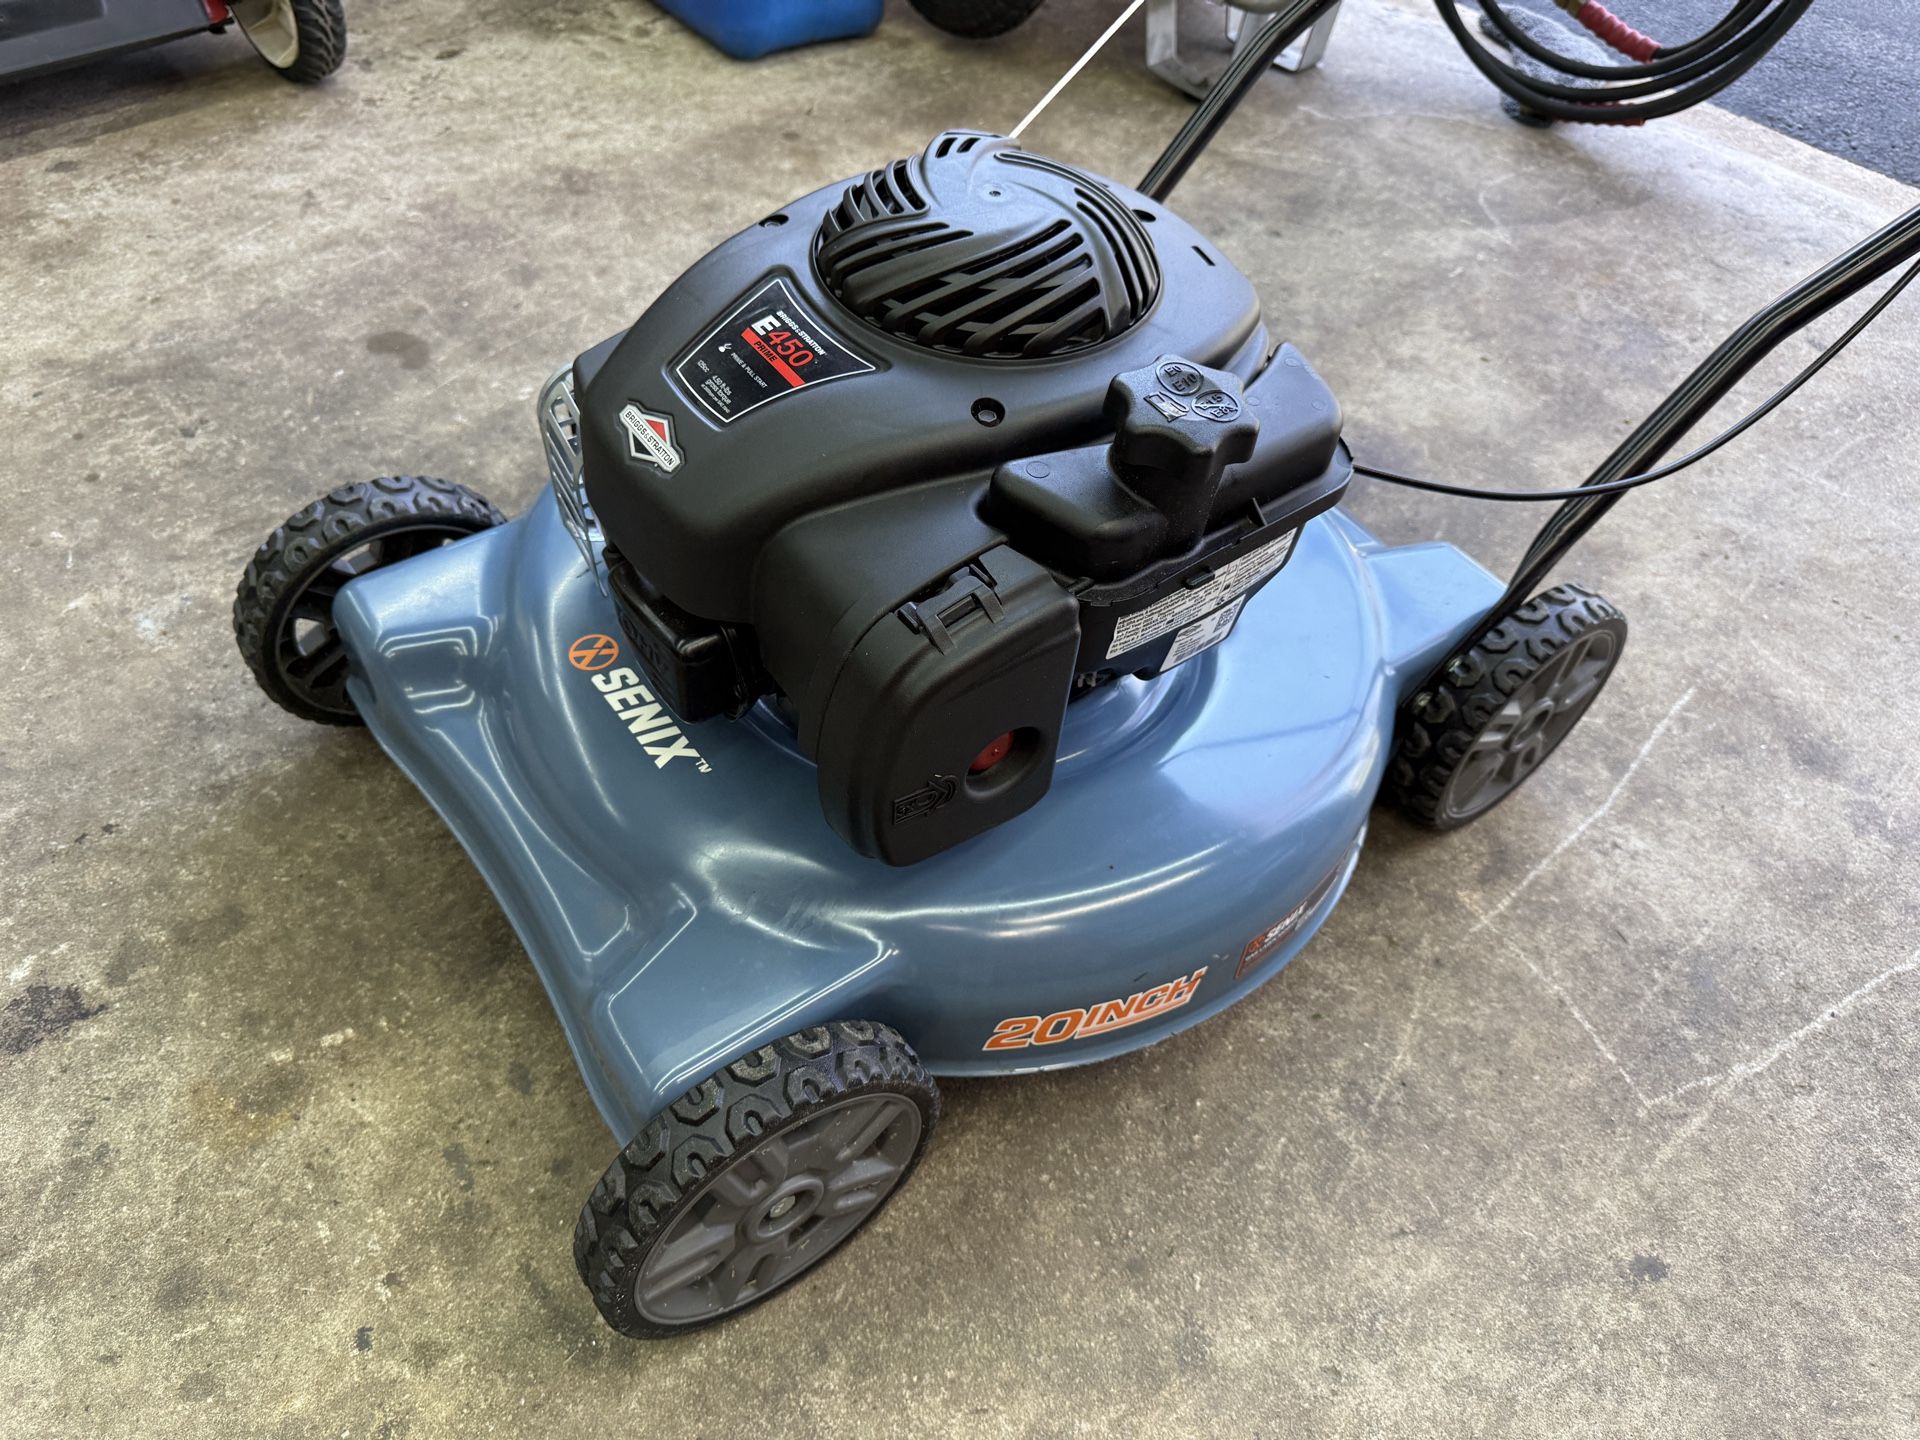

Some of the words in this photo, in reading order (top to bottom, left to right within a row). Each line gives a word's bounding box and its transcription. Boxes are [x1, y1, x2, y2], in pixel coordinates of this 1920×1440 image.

[754, 341, 778, 362] PRIME
[731, 352, 744, 366] PRIME
[744, 366, 755, 378] PULL
[753, 375, 768, 389] START
[1163, 365, 1183, 378] E0
[1172, 373, 1197, 392] E10
[717, 389, 732, 405] torque
[590, 667, 701, 769] SENIX
[1076, 965, 1209, 1032] INCH
